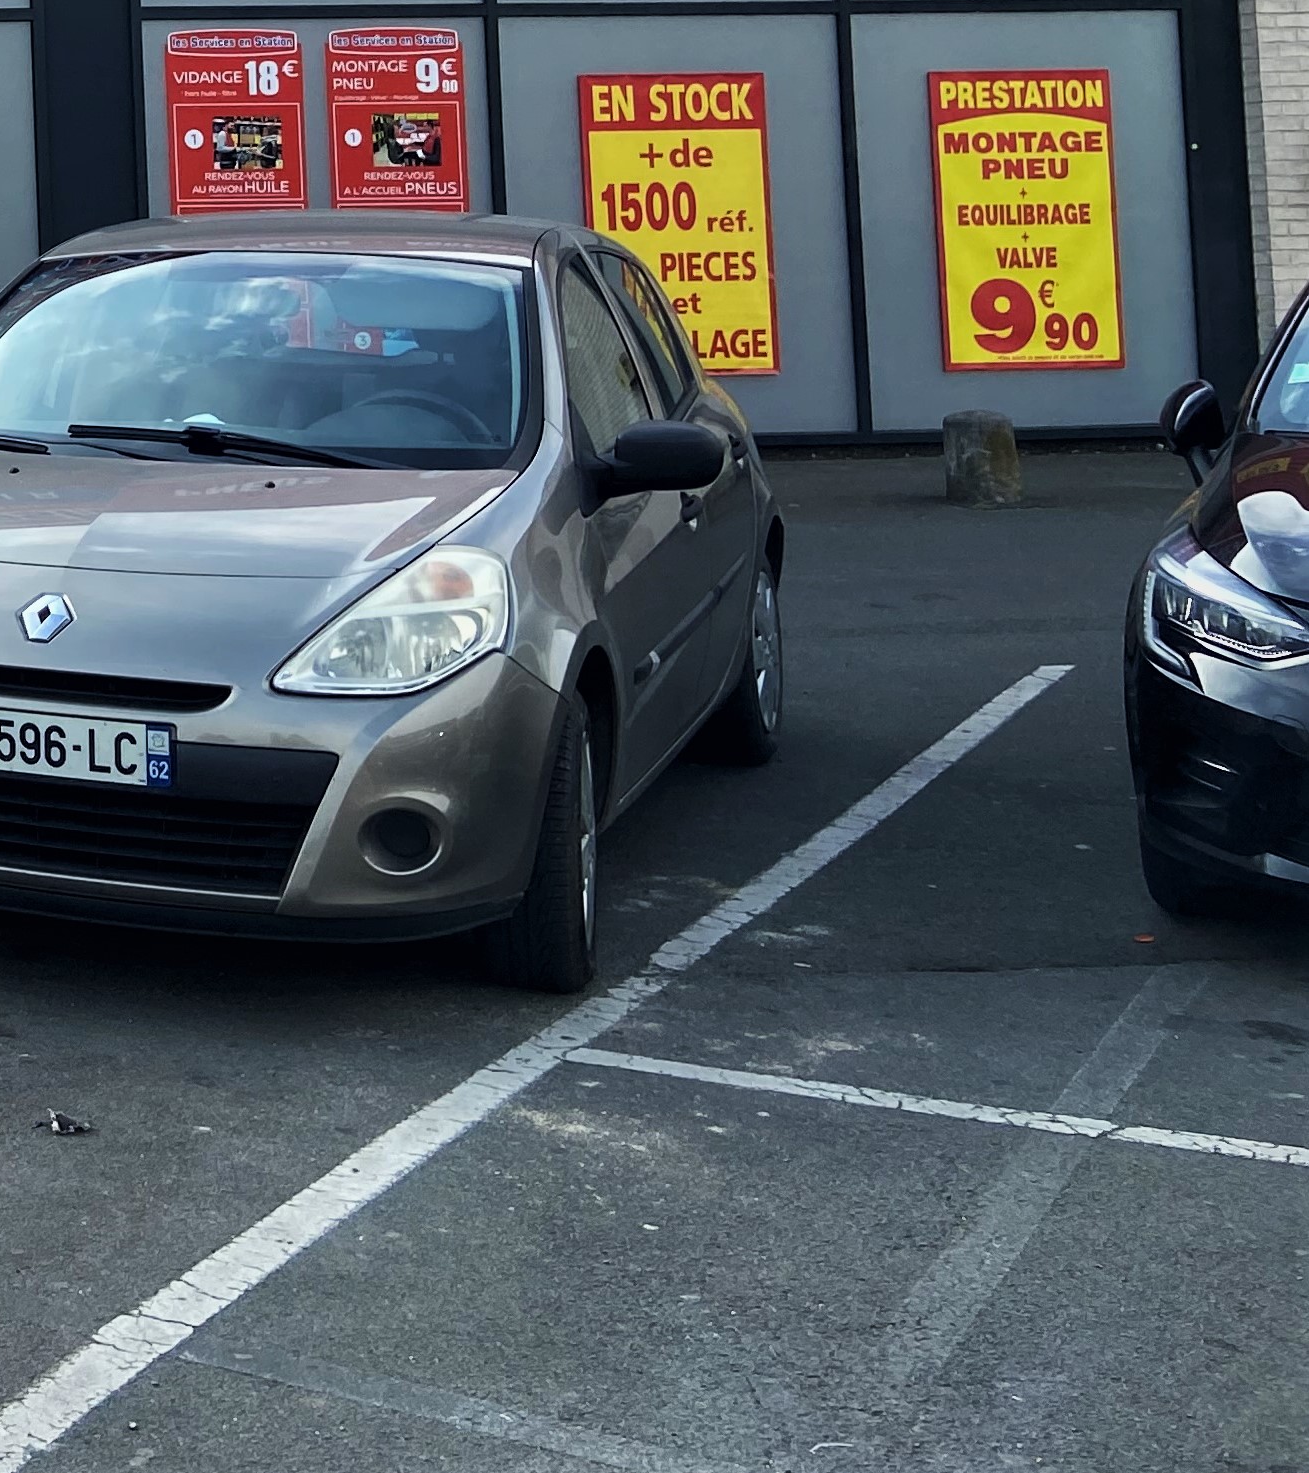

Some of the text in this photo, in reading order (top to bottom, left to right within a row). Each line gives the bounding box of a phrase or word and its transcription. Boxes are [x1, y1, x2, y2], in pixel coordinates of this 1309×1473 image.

[173, 71, 243, 84] VIDANGE
[332, 59, 409, 73] MONTAGE
[333, 77, 374, 90] PNEU
[938, 79, 1104, 110] PRESTATION
[591, 82, 755, 123] EN STOCK
[669, 138, 714, 168] de
[943, 131, 1103, 154] MONTAGE
[205, 171, 275, 181] RENDEZ-VOUS
[364, 171, 435, 181] RENDEZ-VOUS
[981, 157, 1070, 180] PNEU
[192, 181, 289, 194] AU RAYON HUILE
[405, 181, 458, 195] PNEUS
[601, 181, 754, 233] 1500 réf.
[957, 203, 1091, 226] EQUILIBRAGE
[660, 251, 757, 282] PIECES
[996, 246, 1058, 269] VALVE
[672, 292, 703, 315] et
[691, 328, 768, 359] LAGE
[148, 759, 170, 780] 62
